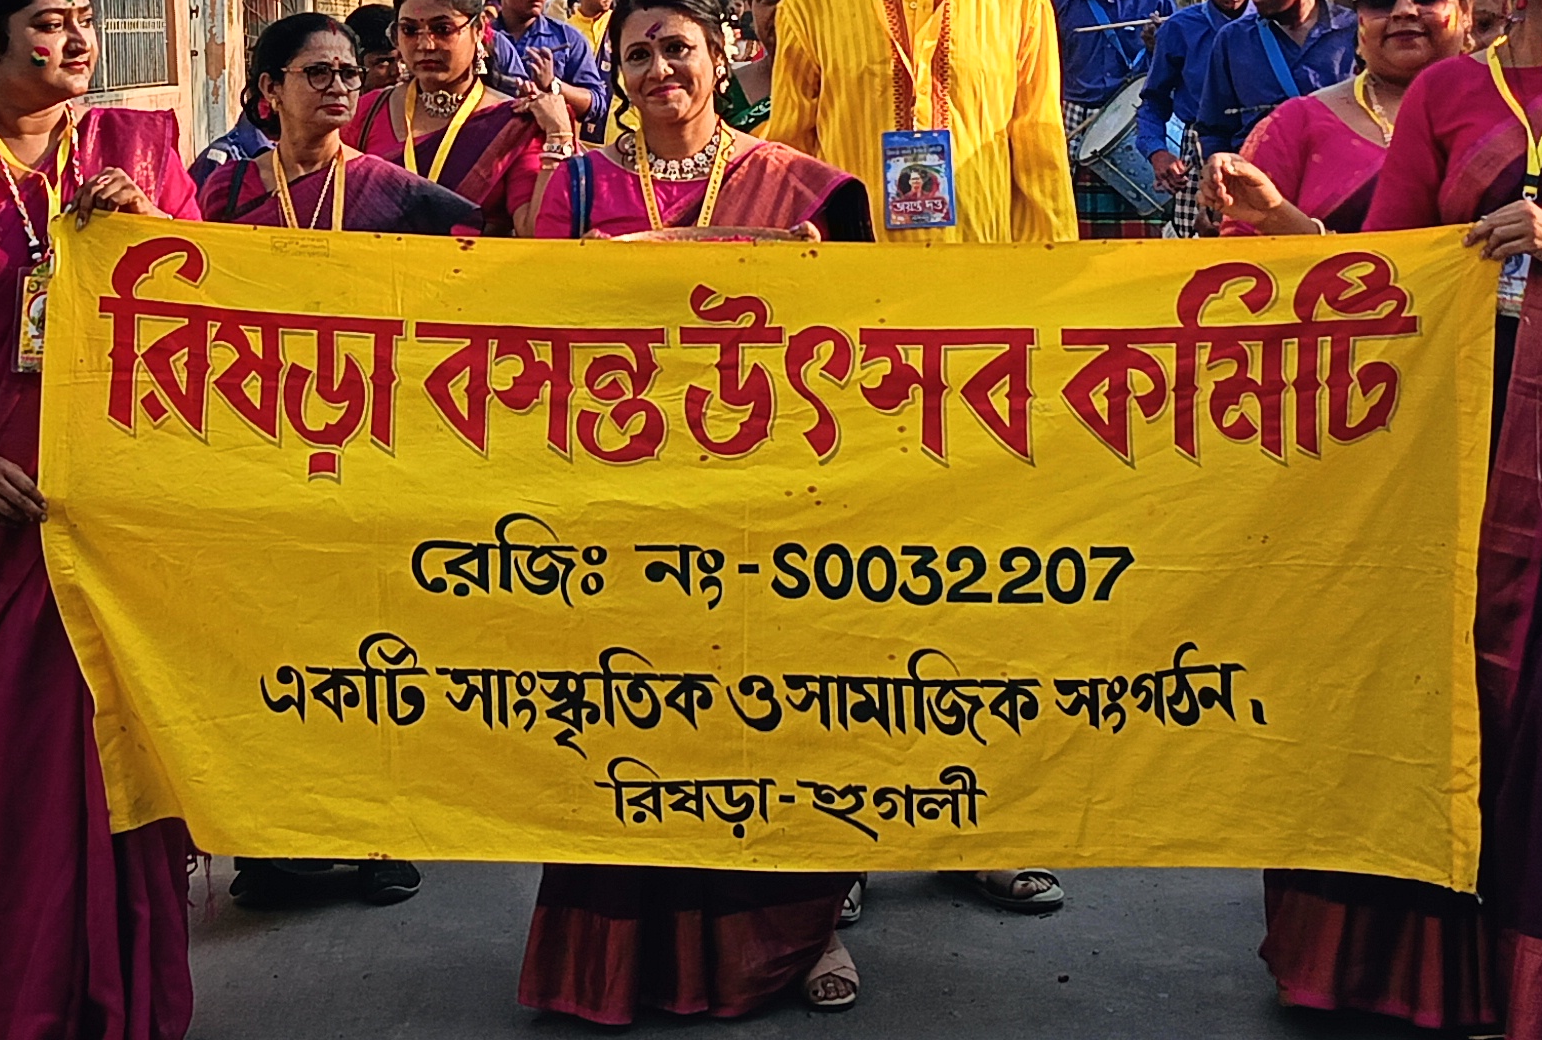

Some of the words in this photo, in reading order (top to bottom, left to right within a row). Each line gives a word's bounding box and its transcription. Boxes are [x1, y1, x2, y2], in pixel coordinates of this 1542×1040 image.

[99, 237, 404, 479] রিষড়া
[416, 321, 667, 463] বসন্ত
[680, 285, 1036, 460] উৎসব
[1062, 251, 1419, 462] কমিটি
[260, 632, 429, 726] একটি
[436, 646, 721, 762] সাংস্কৃতিক
[725, 674, 783, 732] ও
[783, 648, 1042, 746] সামাজিক
